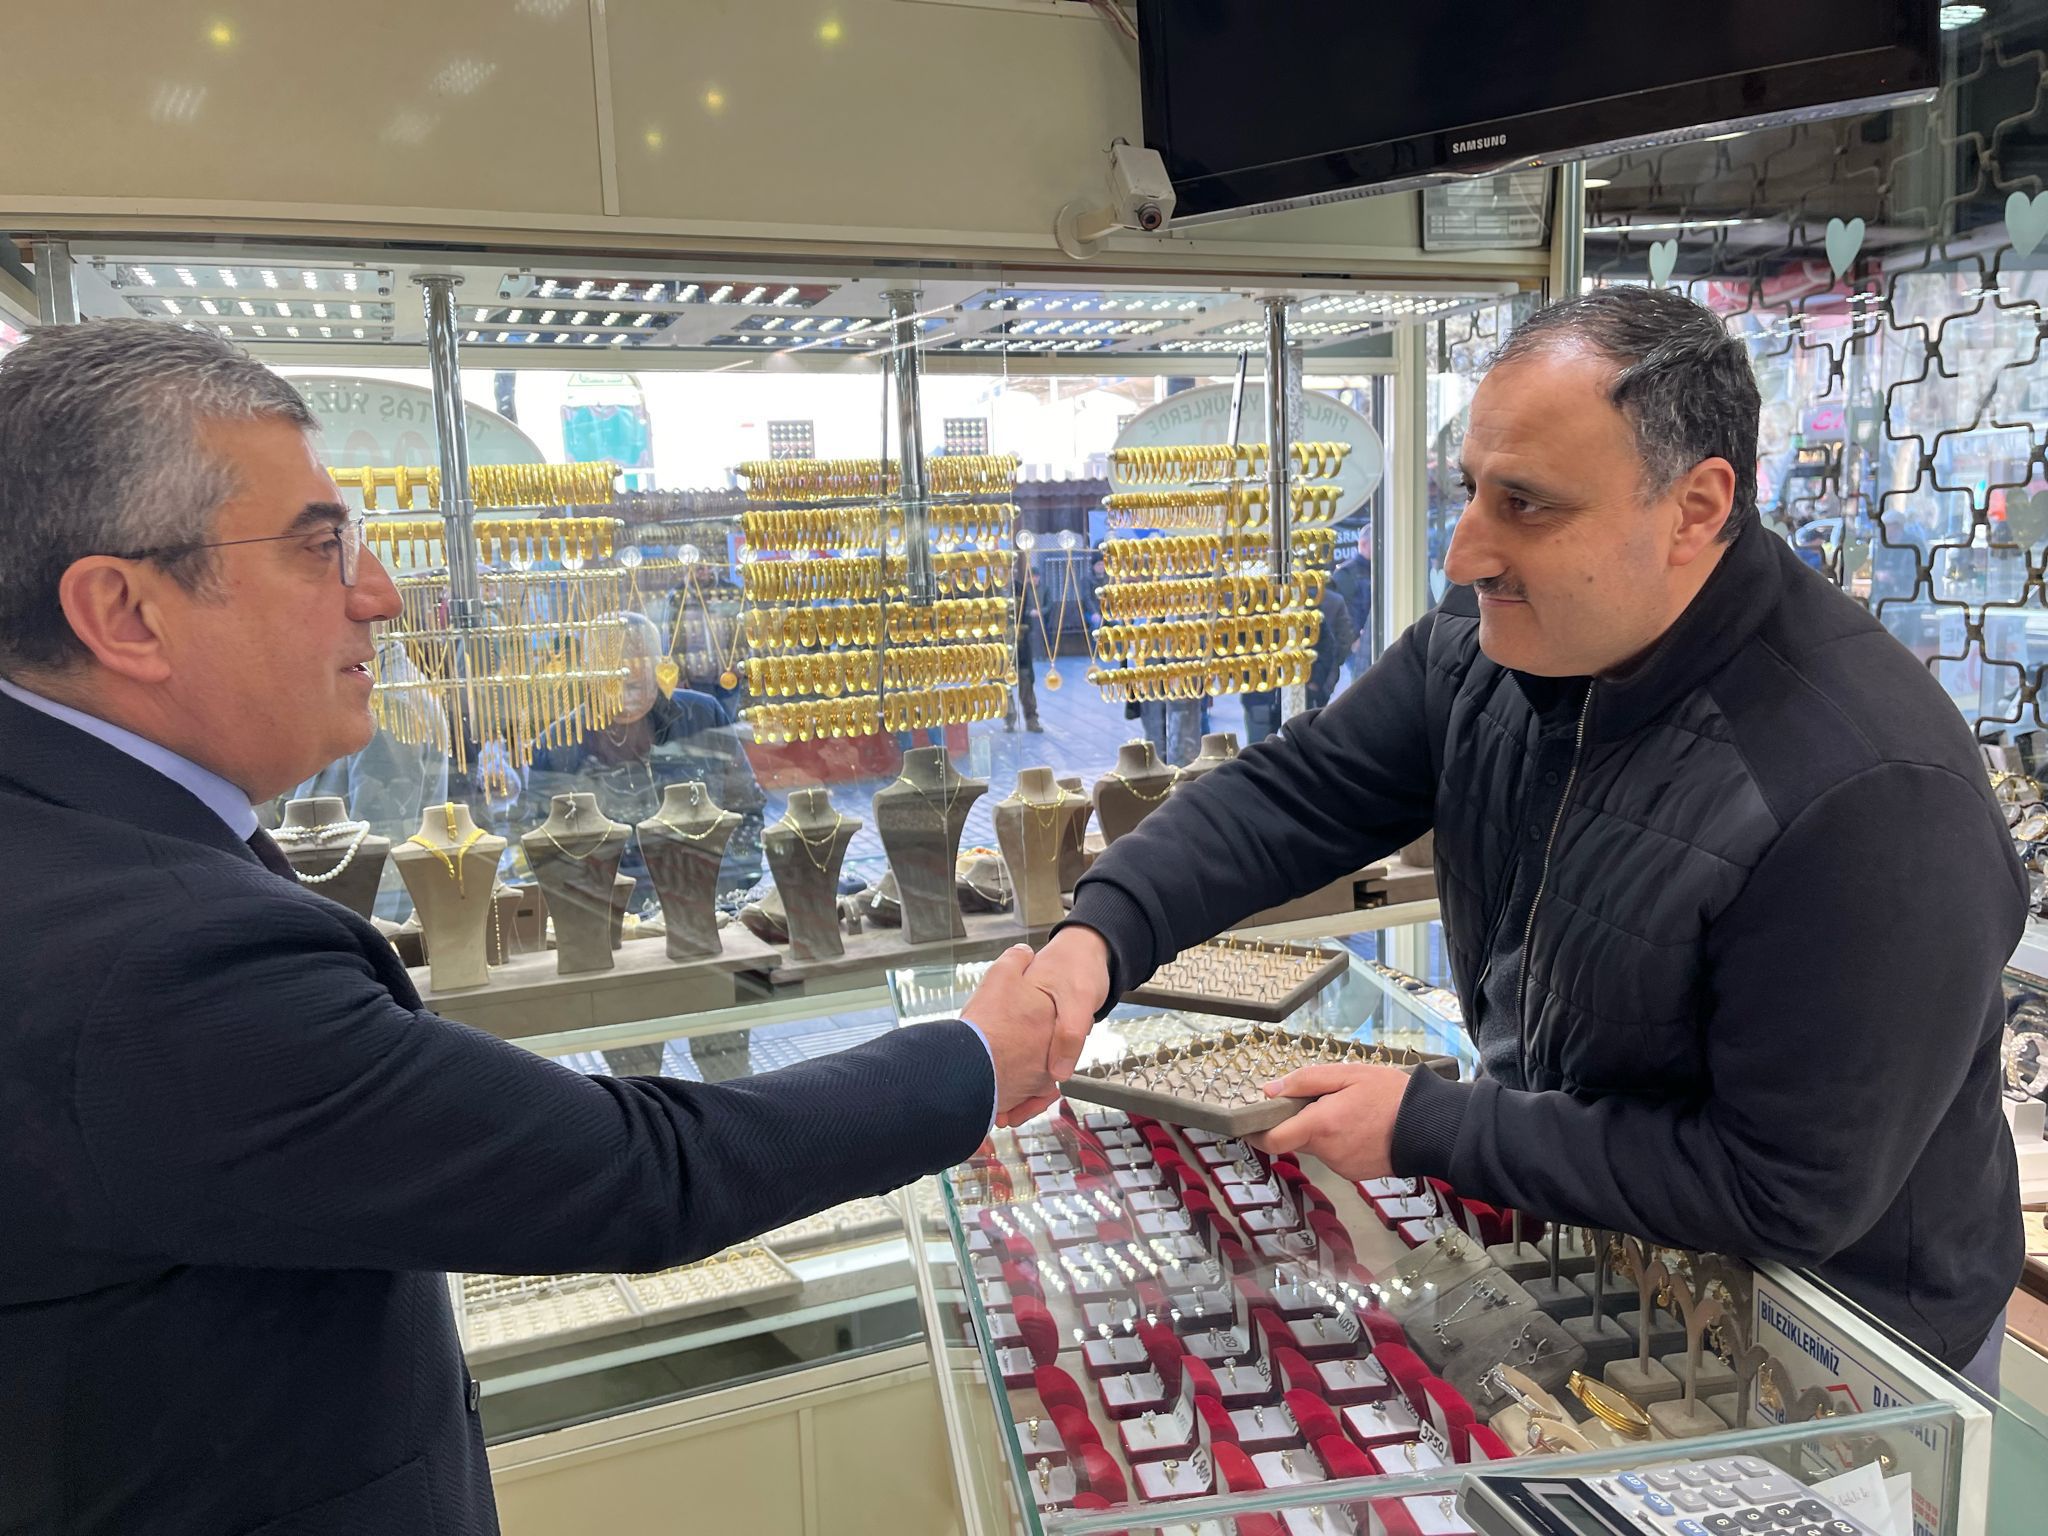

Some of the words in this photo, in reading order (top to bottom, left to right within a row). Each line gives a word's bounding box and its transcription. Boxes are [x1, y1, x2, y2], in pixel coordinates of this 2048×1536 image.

[1452, 134, 1507, 154] SAMSUNG
[1761, 1299, 1840, 1376] BİLEZİKLERİMİZ
[1421, 1425, 1444, 1453] 3750
[1192, 1450, 1211, 1484] 4800
[1624, 1474, 1641, 1486] GT
[1747, 1513, 1760, 1521] 6
[1778, 1508, 1791, 1516] 3
[1833, 1521, 1854, 1534] 00
